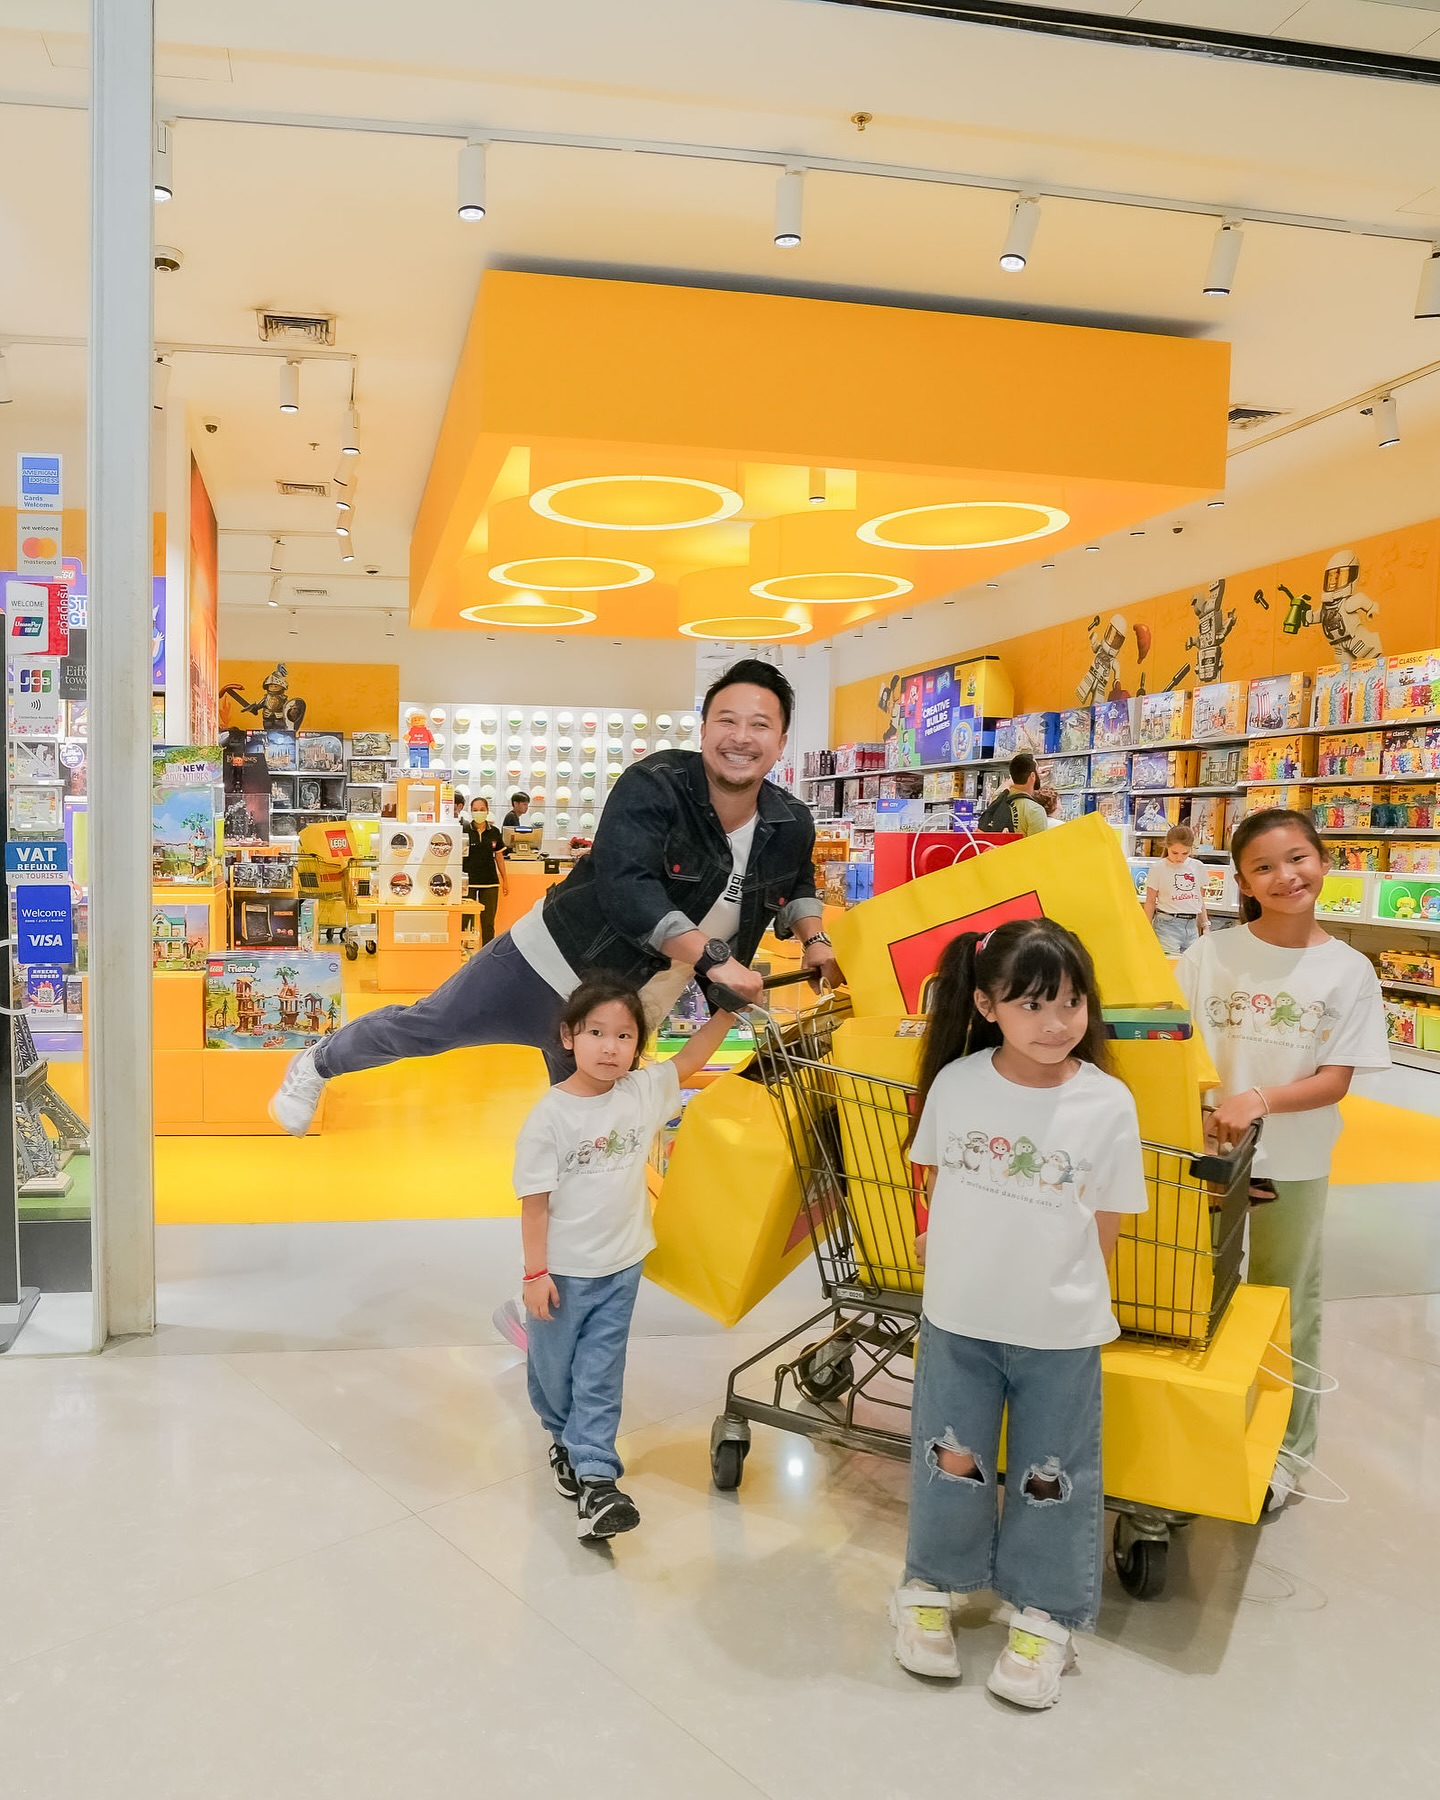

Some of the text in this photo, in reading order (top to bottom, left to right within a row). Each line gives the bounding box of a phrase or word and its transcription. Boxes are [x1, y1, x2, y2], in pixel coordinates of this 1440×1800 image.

[11, 600, 44, 608] WELCOME
[15, 620, 41, 630] UnionPay
[1399, 656, 1422, 665] CLASSIC
[922, 699, 951, 719] CREATIVE
[926, 711, 948, 728] BUILDS
[183, 763, 205, 773] NEW
[166, 772, 209, 781] ADVENTURES
[330, 838, 347, 849] LEGO
[16, 847, 57, 862] VAT
[17, 863, 58, 871] REFUND
[26, 872, 64, 880] TOURISTS
[21, 908, 67, 919] Welcome
[27, 934, 63, 947] VISA
[227, 962, 257, 974] Friends
[1265, 1039, 1294, 1049] dancing
[1001, 1189, 1034, 1204] dancing
[1036, 1197, 1053, 1208] cats
